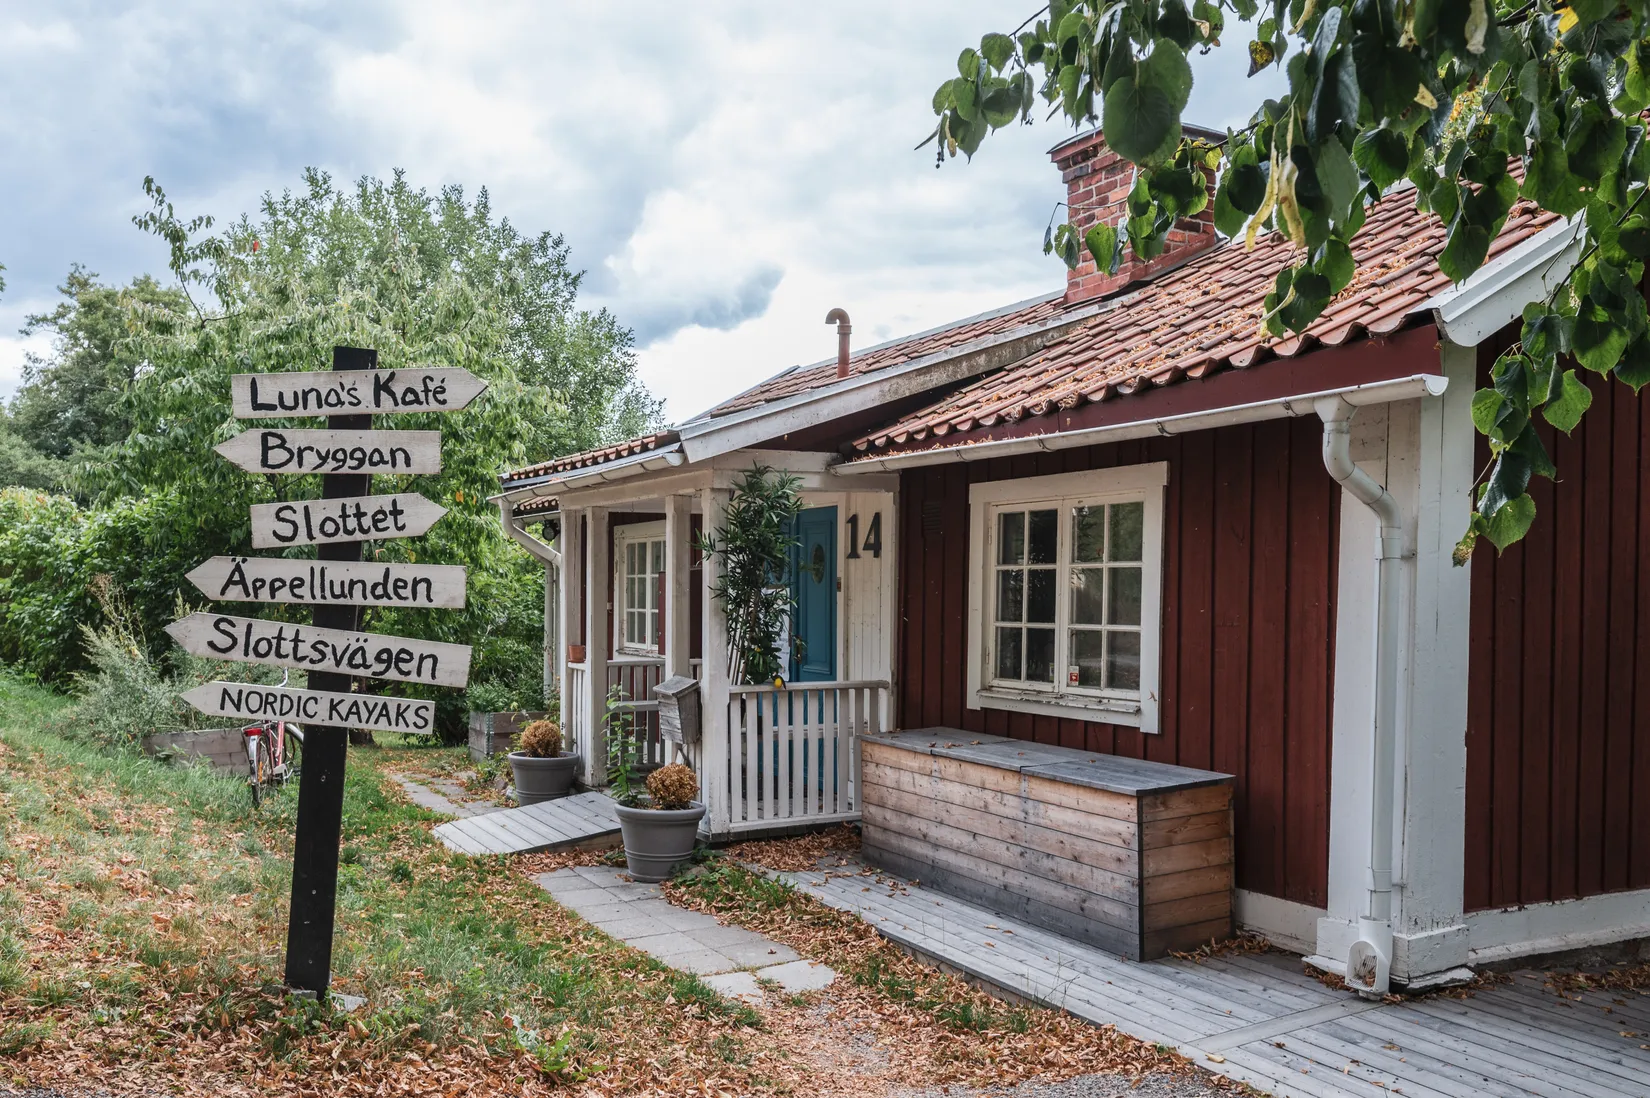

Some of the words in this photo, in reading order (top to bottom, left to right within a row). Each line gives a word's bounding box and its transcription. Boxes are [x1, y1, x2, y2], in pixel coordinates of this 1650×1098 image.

[250, 376, 362, 411] Luna's
[373, 371, 448, 408] Kafé
[260, 431, 412, 471] Bryggan
[272, 498, 406, 543] Slottet
[846, 512, 882, 559] 14
[219, 557, 434, 603] Äppellunden
[206, 617, 439, 680] Slottsvägen
[219, 688, 318, 719] NORDIC
[328, 698, 430, 730] KAYAKS
